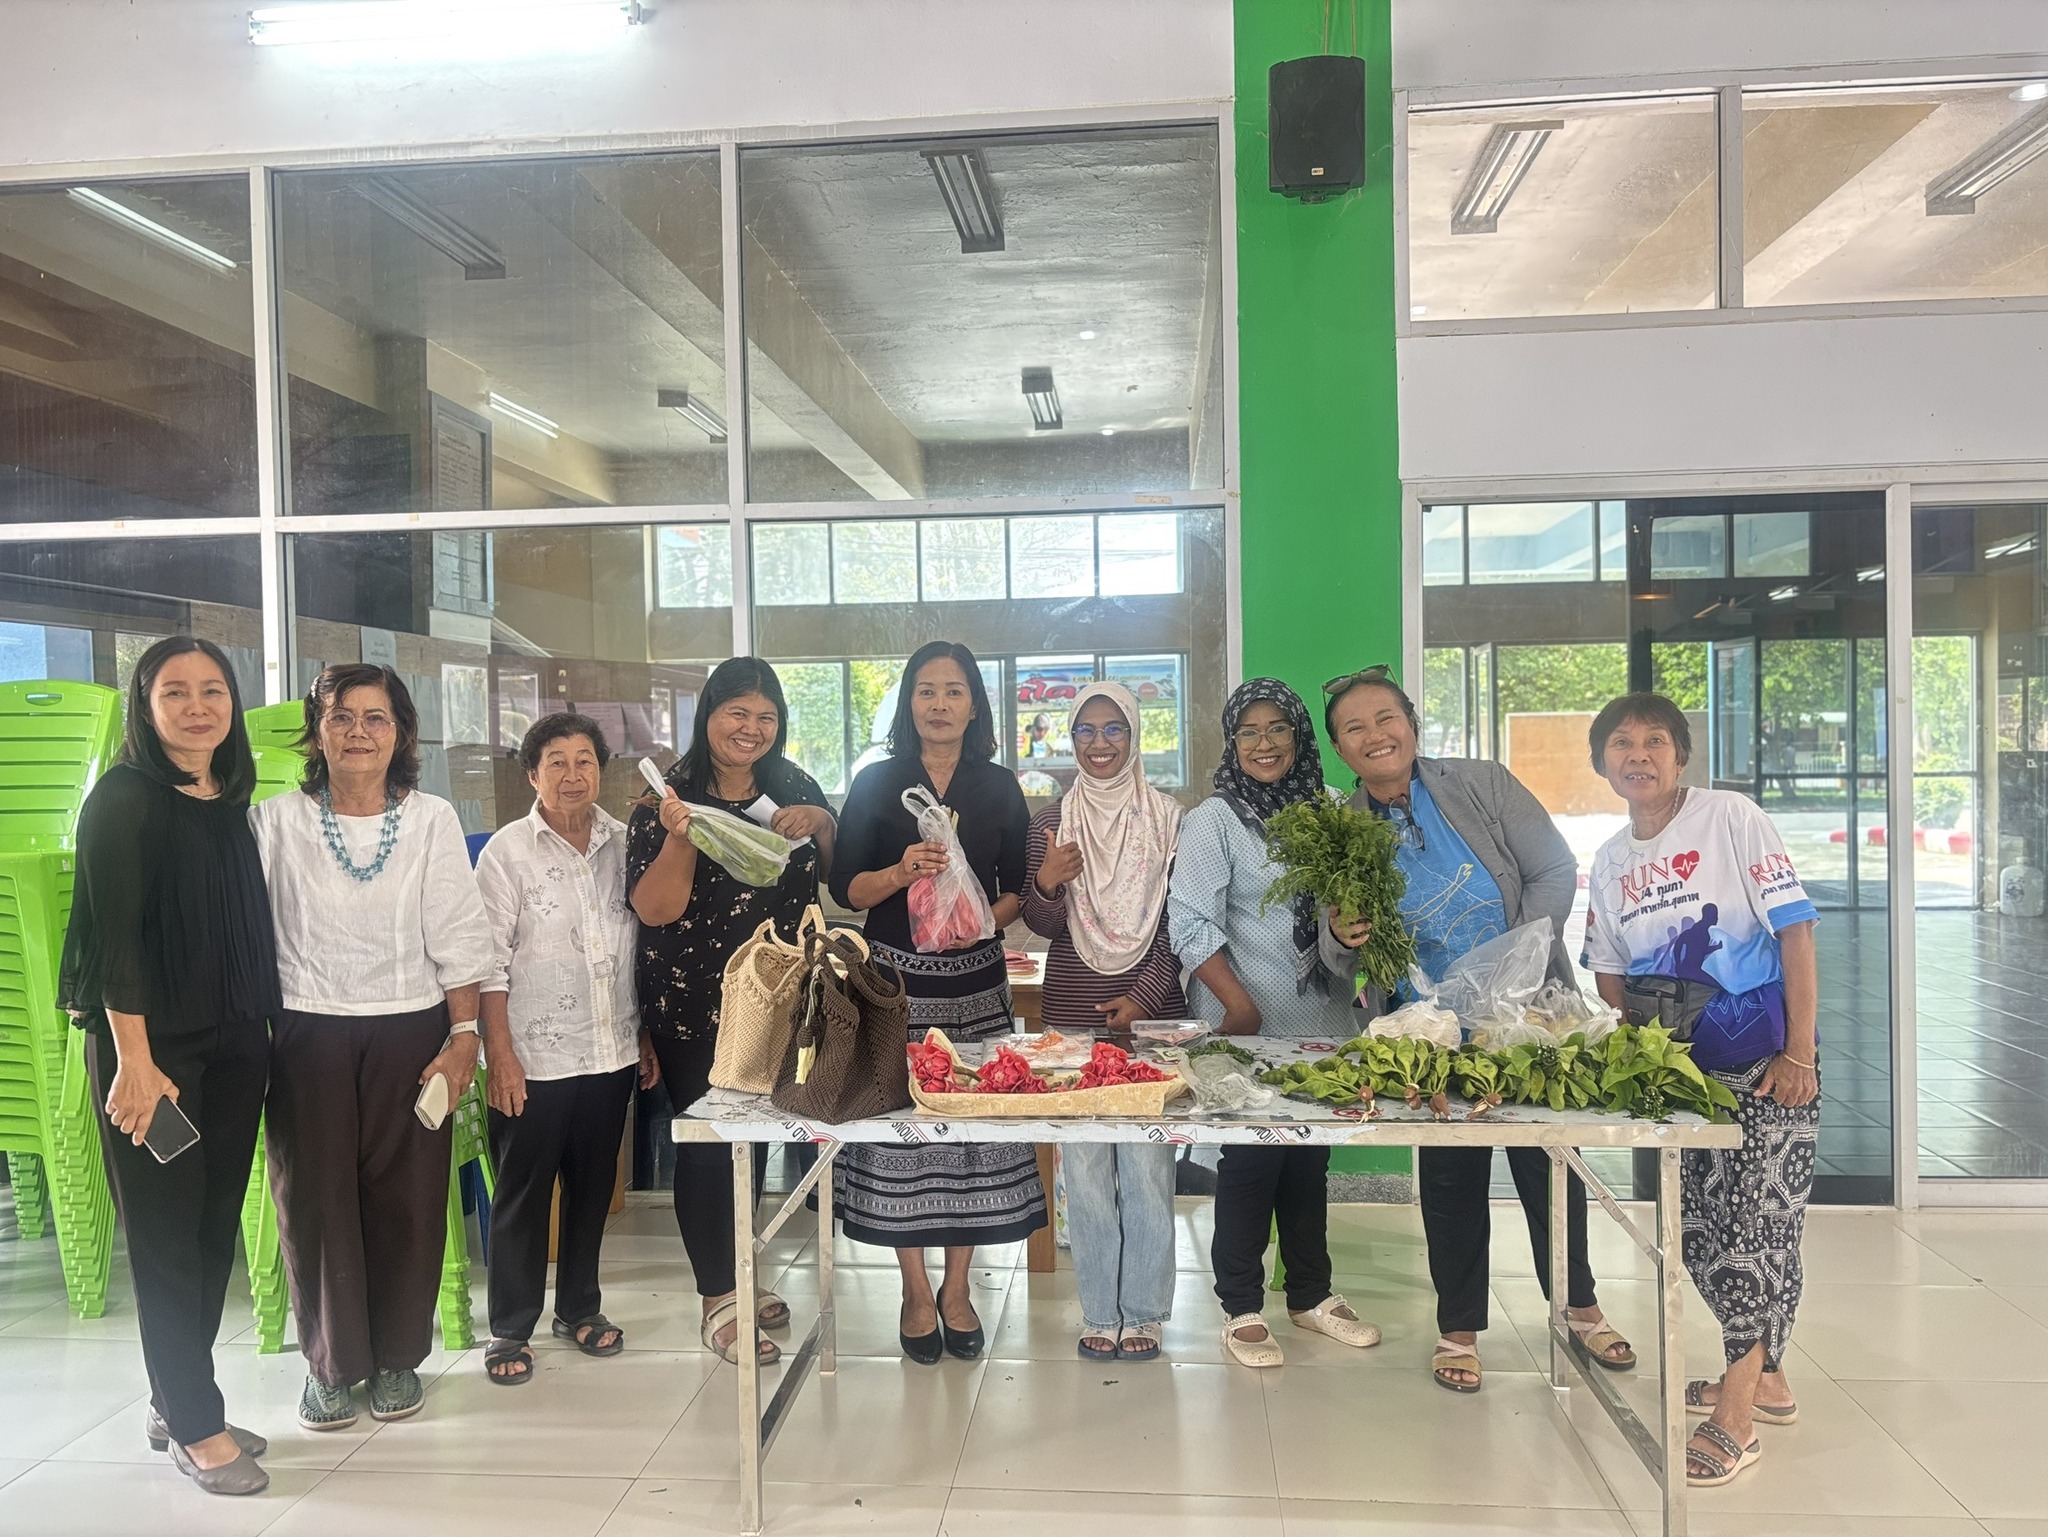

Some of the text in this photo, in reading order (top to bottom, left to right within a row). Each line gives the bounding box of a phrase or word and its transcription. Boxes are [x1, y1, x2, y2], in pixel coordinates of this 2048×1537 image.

[1619, 856, 1670, 912] RUN
[1771, 871, 1784, 881] 14
[1641, 880, 1683, 900] 14 กุมภา
